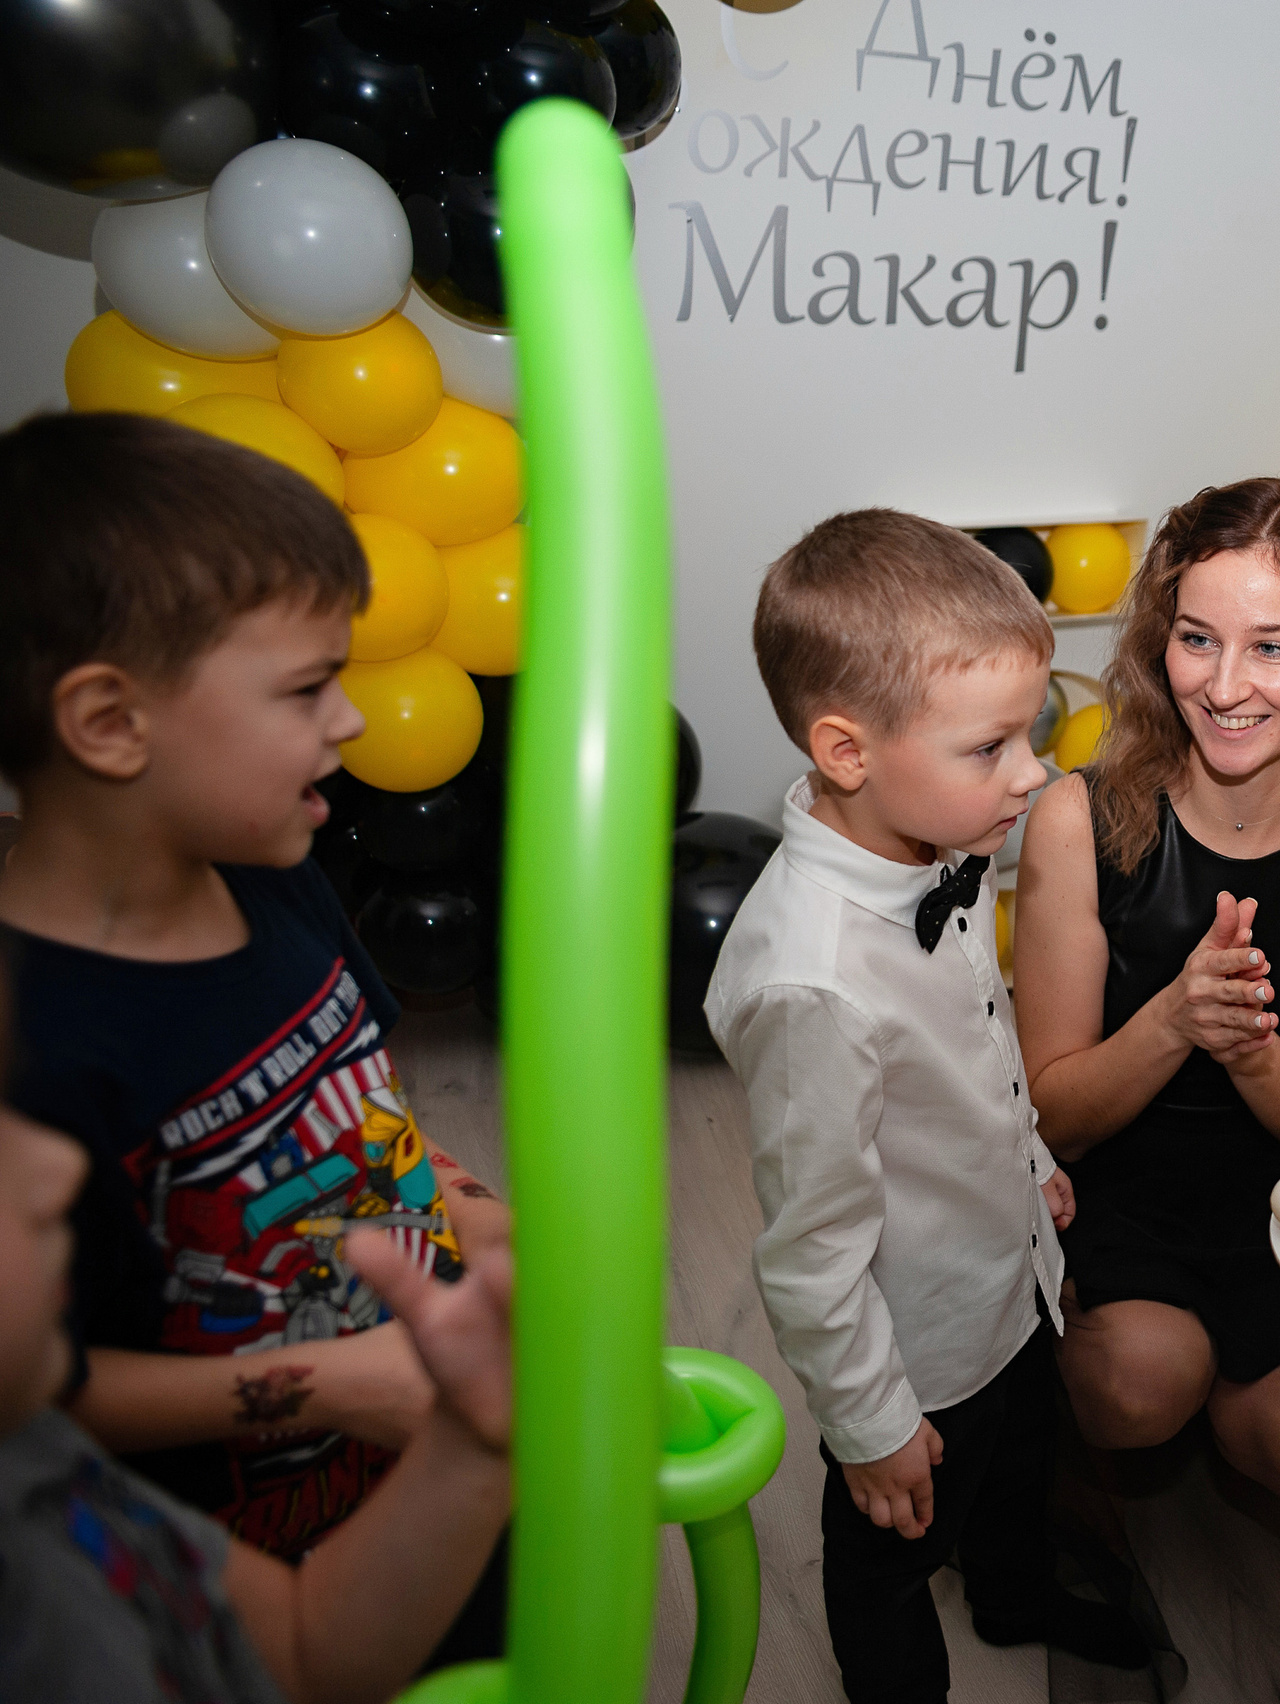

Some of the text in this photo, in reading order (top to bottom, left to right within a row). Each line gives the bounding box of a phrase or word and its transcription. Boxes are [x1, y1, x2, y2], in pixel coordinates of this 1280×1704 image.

[855, 0, 1129, 117] Днём
[636, 77, 1138, 217] ождения!
[667, 200, 1119, 374] Макар!
